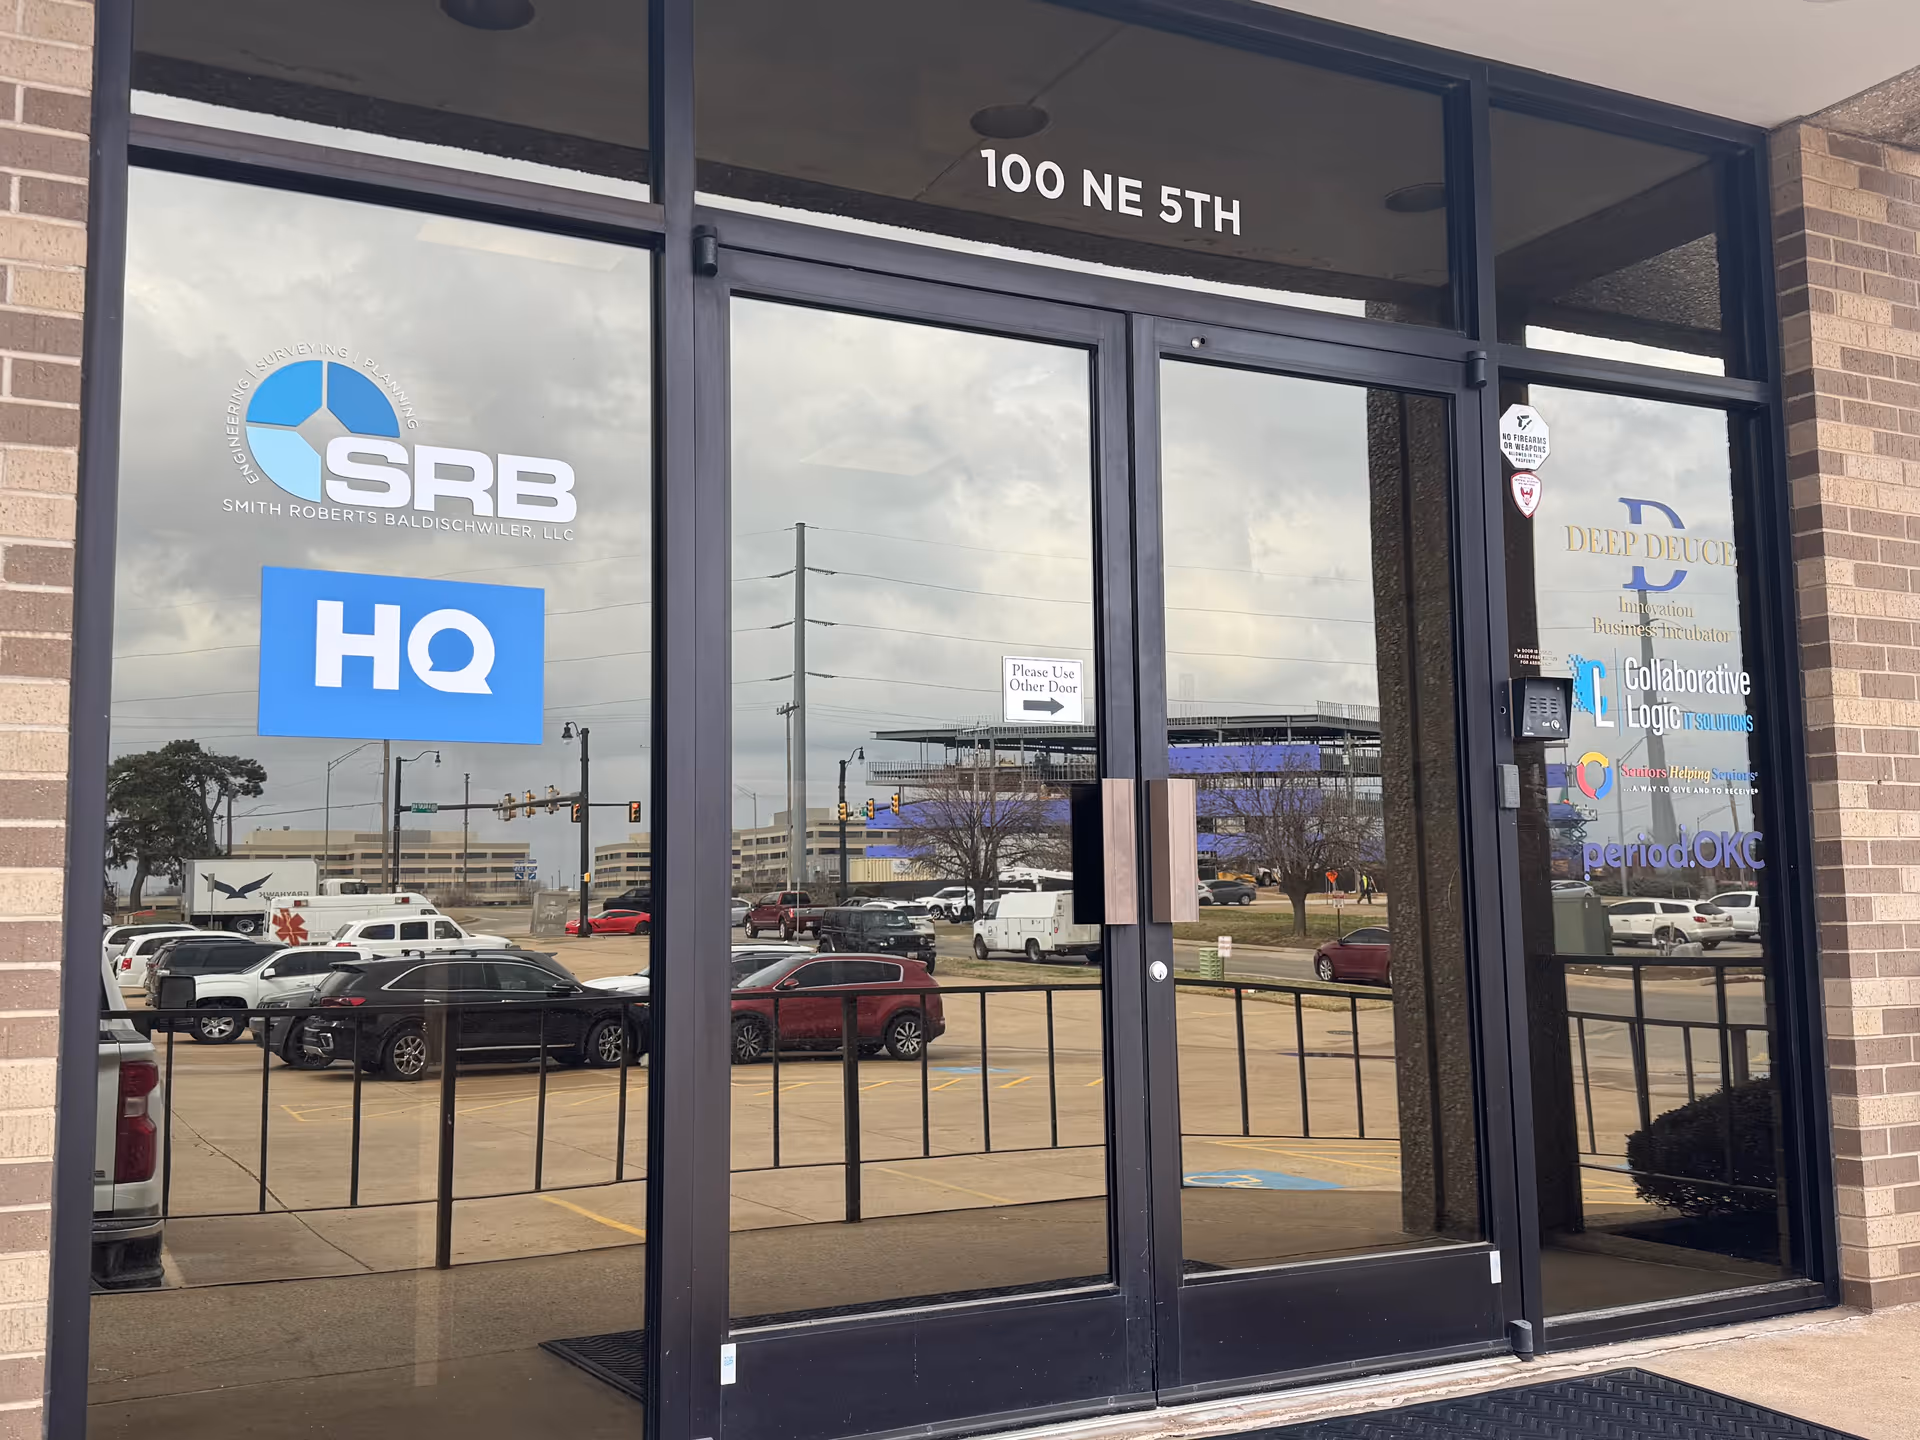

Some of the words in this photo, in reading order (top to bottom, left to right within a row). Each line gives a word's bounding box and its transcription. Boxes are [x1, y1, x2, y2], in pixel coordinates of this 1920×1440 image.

[980, 148, 1065, 200] 100
[1083, 168, 1143, 217] NE
[1159, 185, 1241, 236] 5TH
[226, 378, 260, 485] ENGINEERING
[255, 342, 348, 372] SURVEYING
[363, 357, 418, 431] PLANNING
[1502, 432, 1511, 441] NO
[1513, 434, 1547, 445] FIREARMS
[1504, 441, 1513, 450] OR
[1515, 443, 1546, 453] WEAPONS
[325, 436, 578, 523] SRB
[222, 498, 282, 518] SMITH
[289, 504, 377, 525] ROBERTS
[385, 513, 536, 539] BALDISCHWILER,
[543, 527, 574, 541] LLC
[1565, 524, 1639, 557] DEEP
[1645, 533, 1738, 566] DEUCE
[1618, 595, 1694, 618] Innovation
[315, 599, 496, 695] HQ
[1592, 617, 1658, 637] Business
[1661, 622, 1731, 643] Incubator
[1009, 678, 1044, 692] Other
[1049, 680, 1078, 693] Door
[1012, 664, 1048, 678] Please
[1052, 666, 1075, 679] Use
[1623, 656, 1751, 695] Collaborative
[1626, 695, 1681, 735] Logic
[1682, 713, 1694, 731] IT
[1695, 713, 1754, 732] SOLUTIONS
[1640, 785, 1657, 793] WAY
[1672, 786, 1691, 794] GIVE
[1669, 765, 1710, 784] Helping
[1583, 824, 1766, 881] period.OKC
